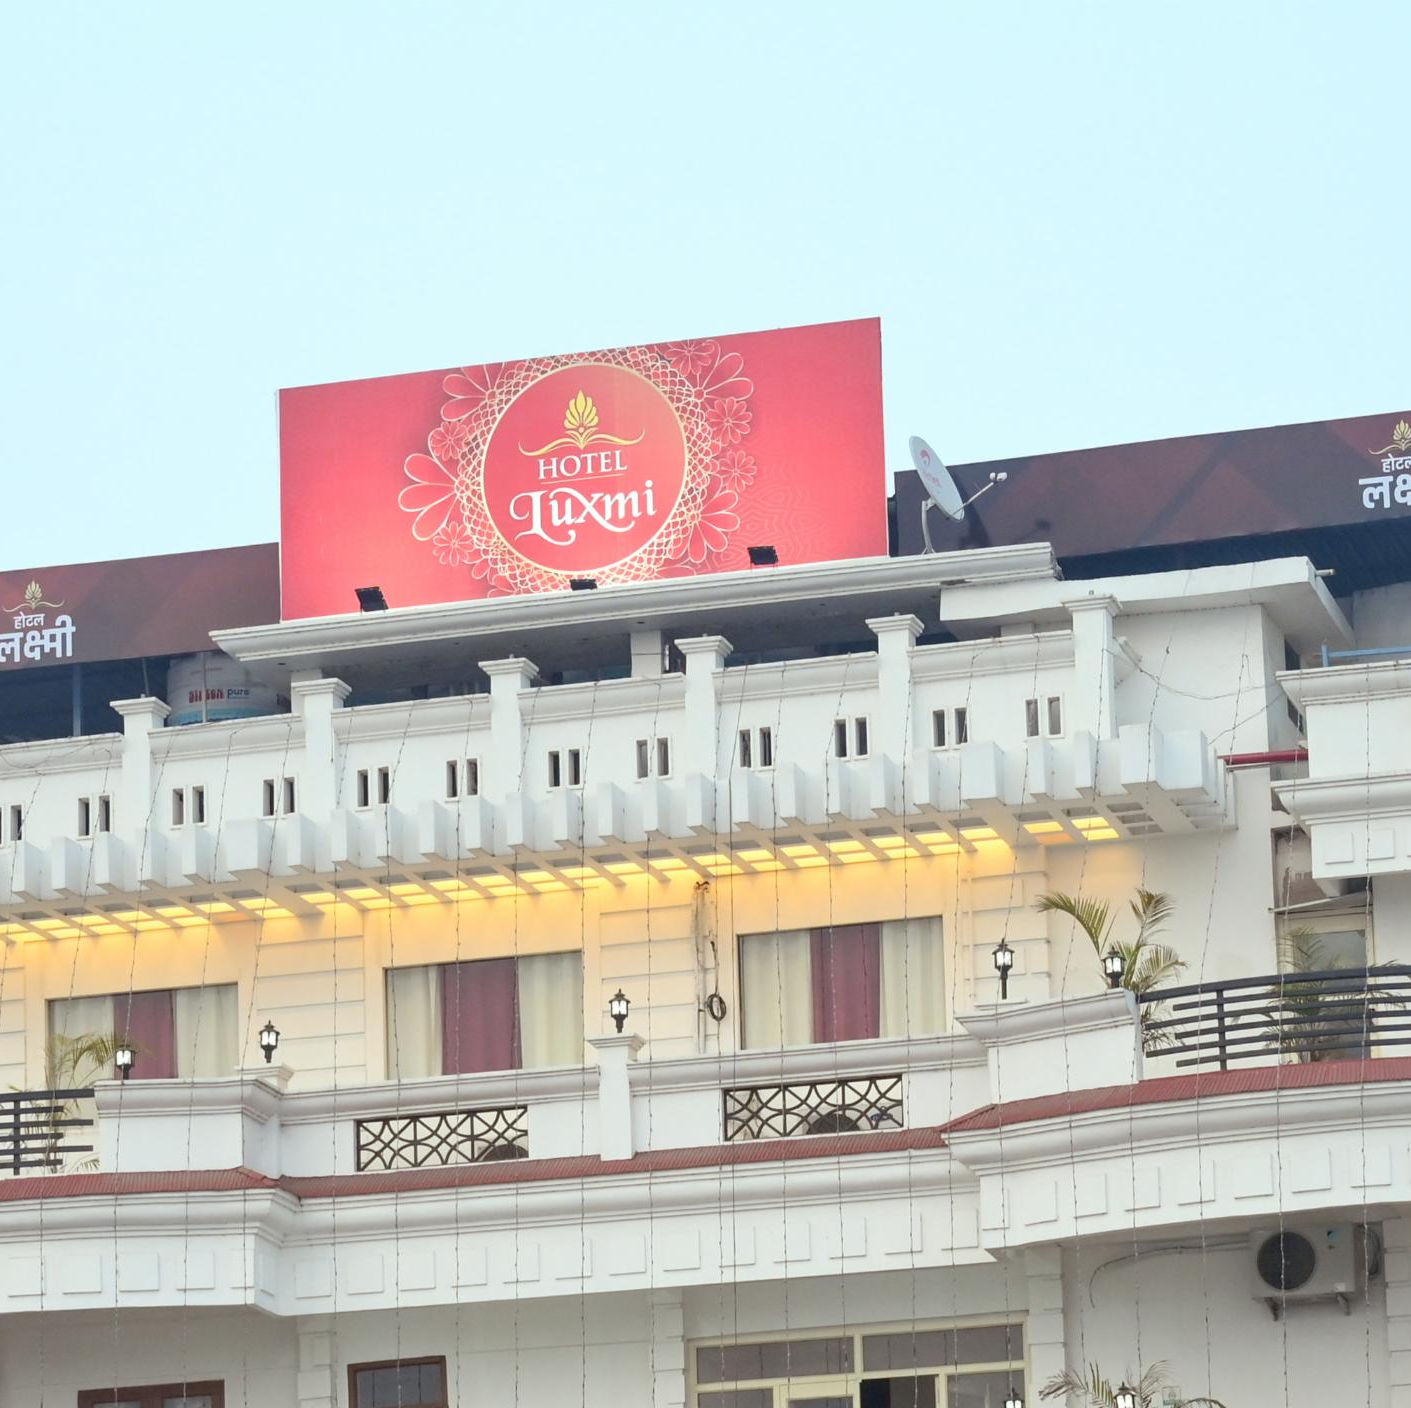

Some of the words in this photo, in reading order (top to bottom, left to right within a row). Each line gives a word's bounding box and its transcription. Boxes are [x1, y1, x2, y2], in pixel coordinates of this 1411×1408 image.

[538, 448, 627, 480] HOTEL
[509, 480, 657, 544] Luxmi
[13, 611, 45, 629] होटल
